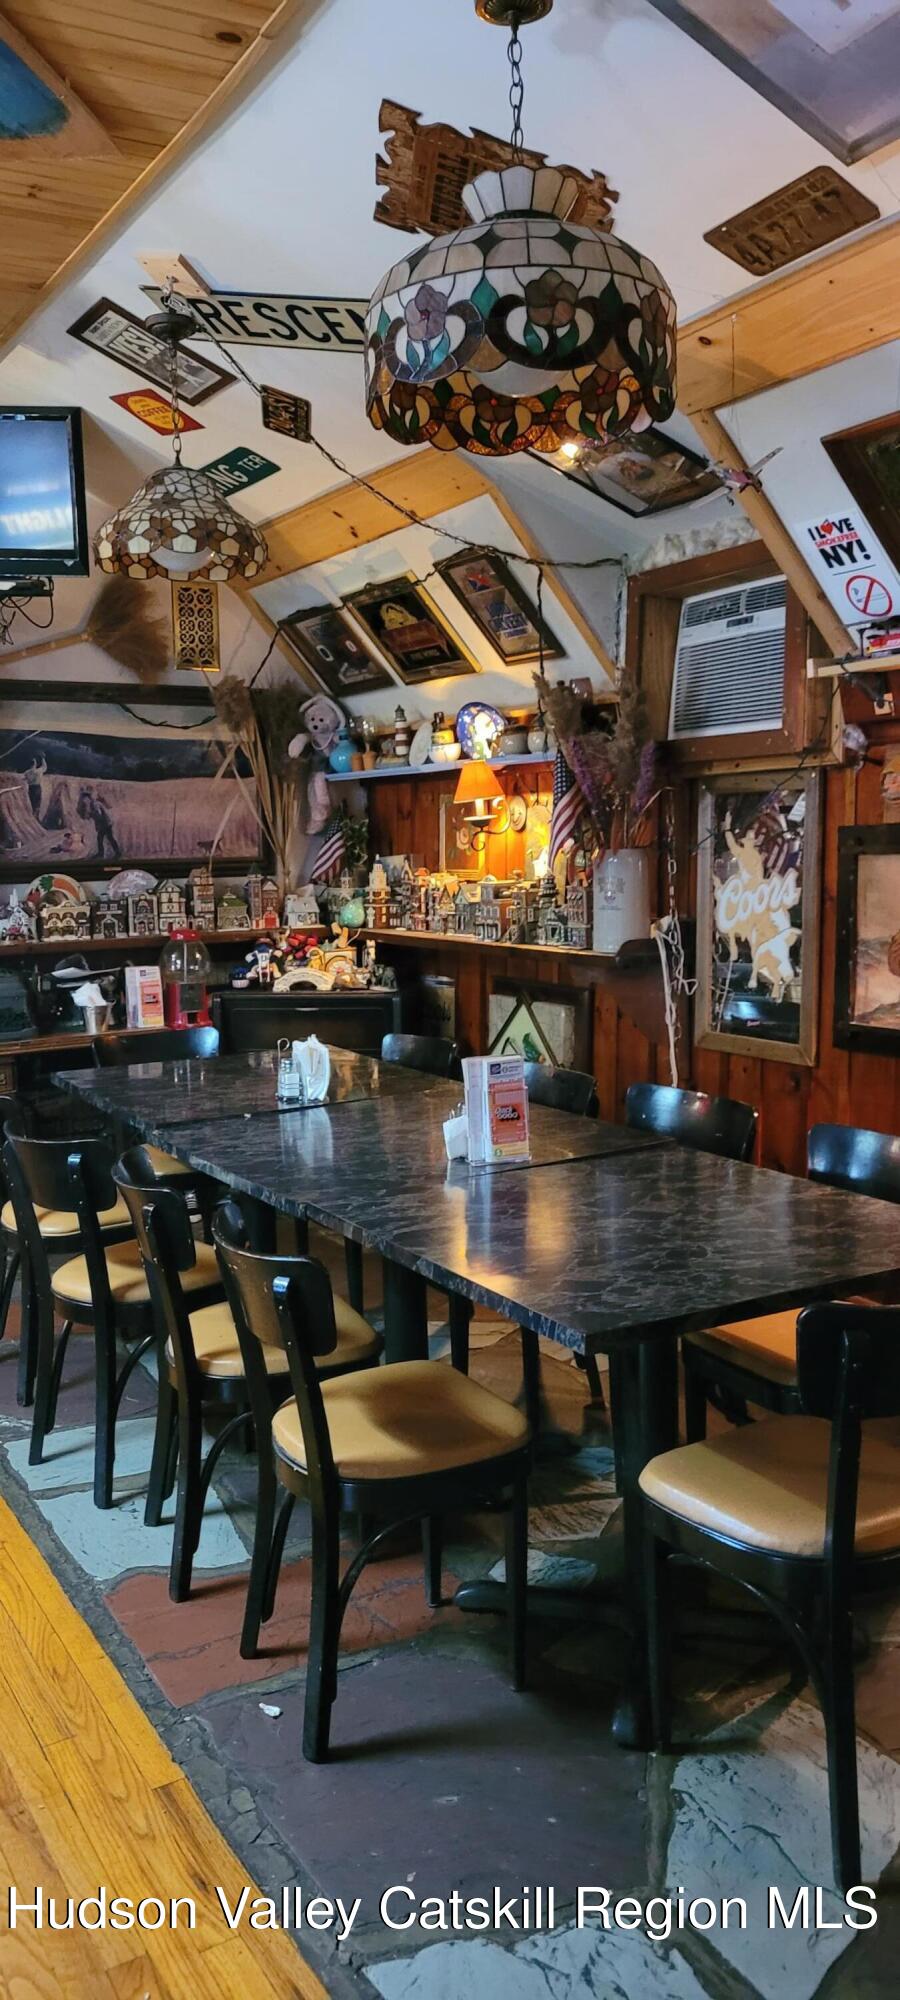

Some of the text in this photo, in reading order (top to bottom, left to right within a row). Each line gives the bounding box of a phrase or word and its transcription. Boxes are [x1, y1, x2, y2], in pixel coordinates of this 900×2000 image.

[108, 326, 166, 365] YES!
[237, 454, 267, 471] TER
[808, 517, 855, 541] I LOVE
[818, 539, 872, 569] NY!
[717, 867, 800, 934] Coors
